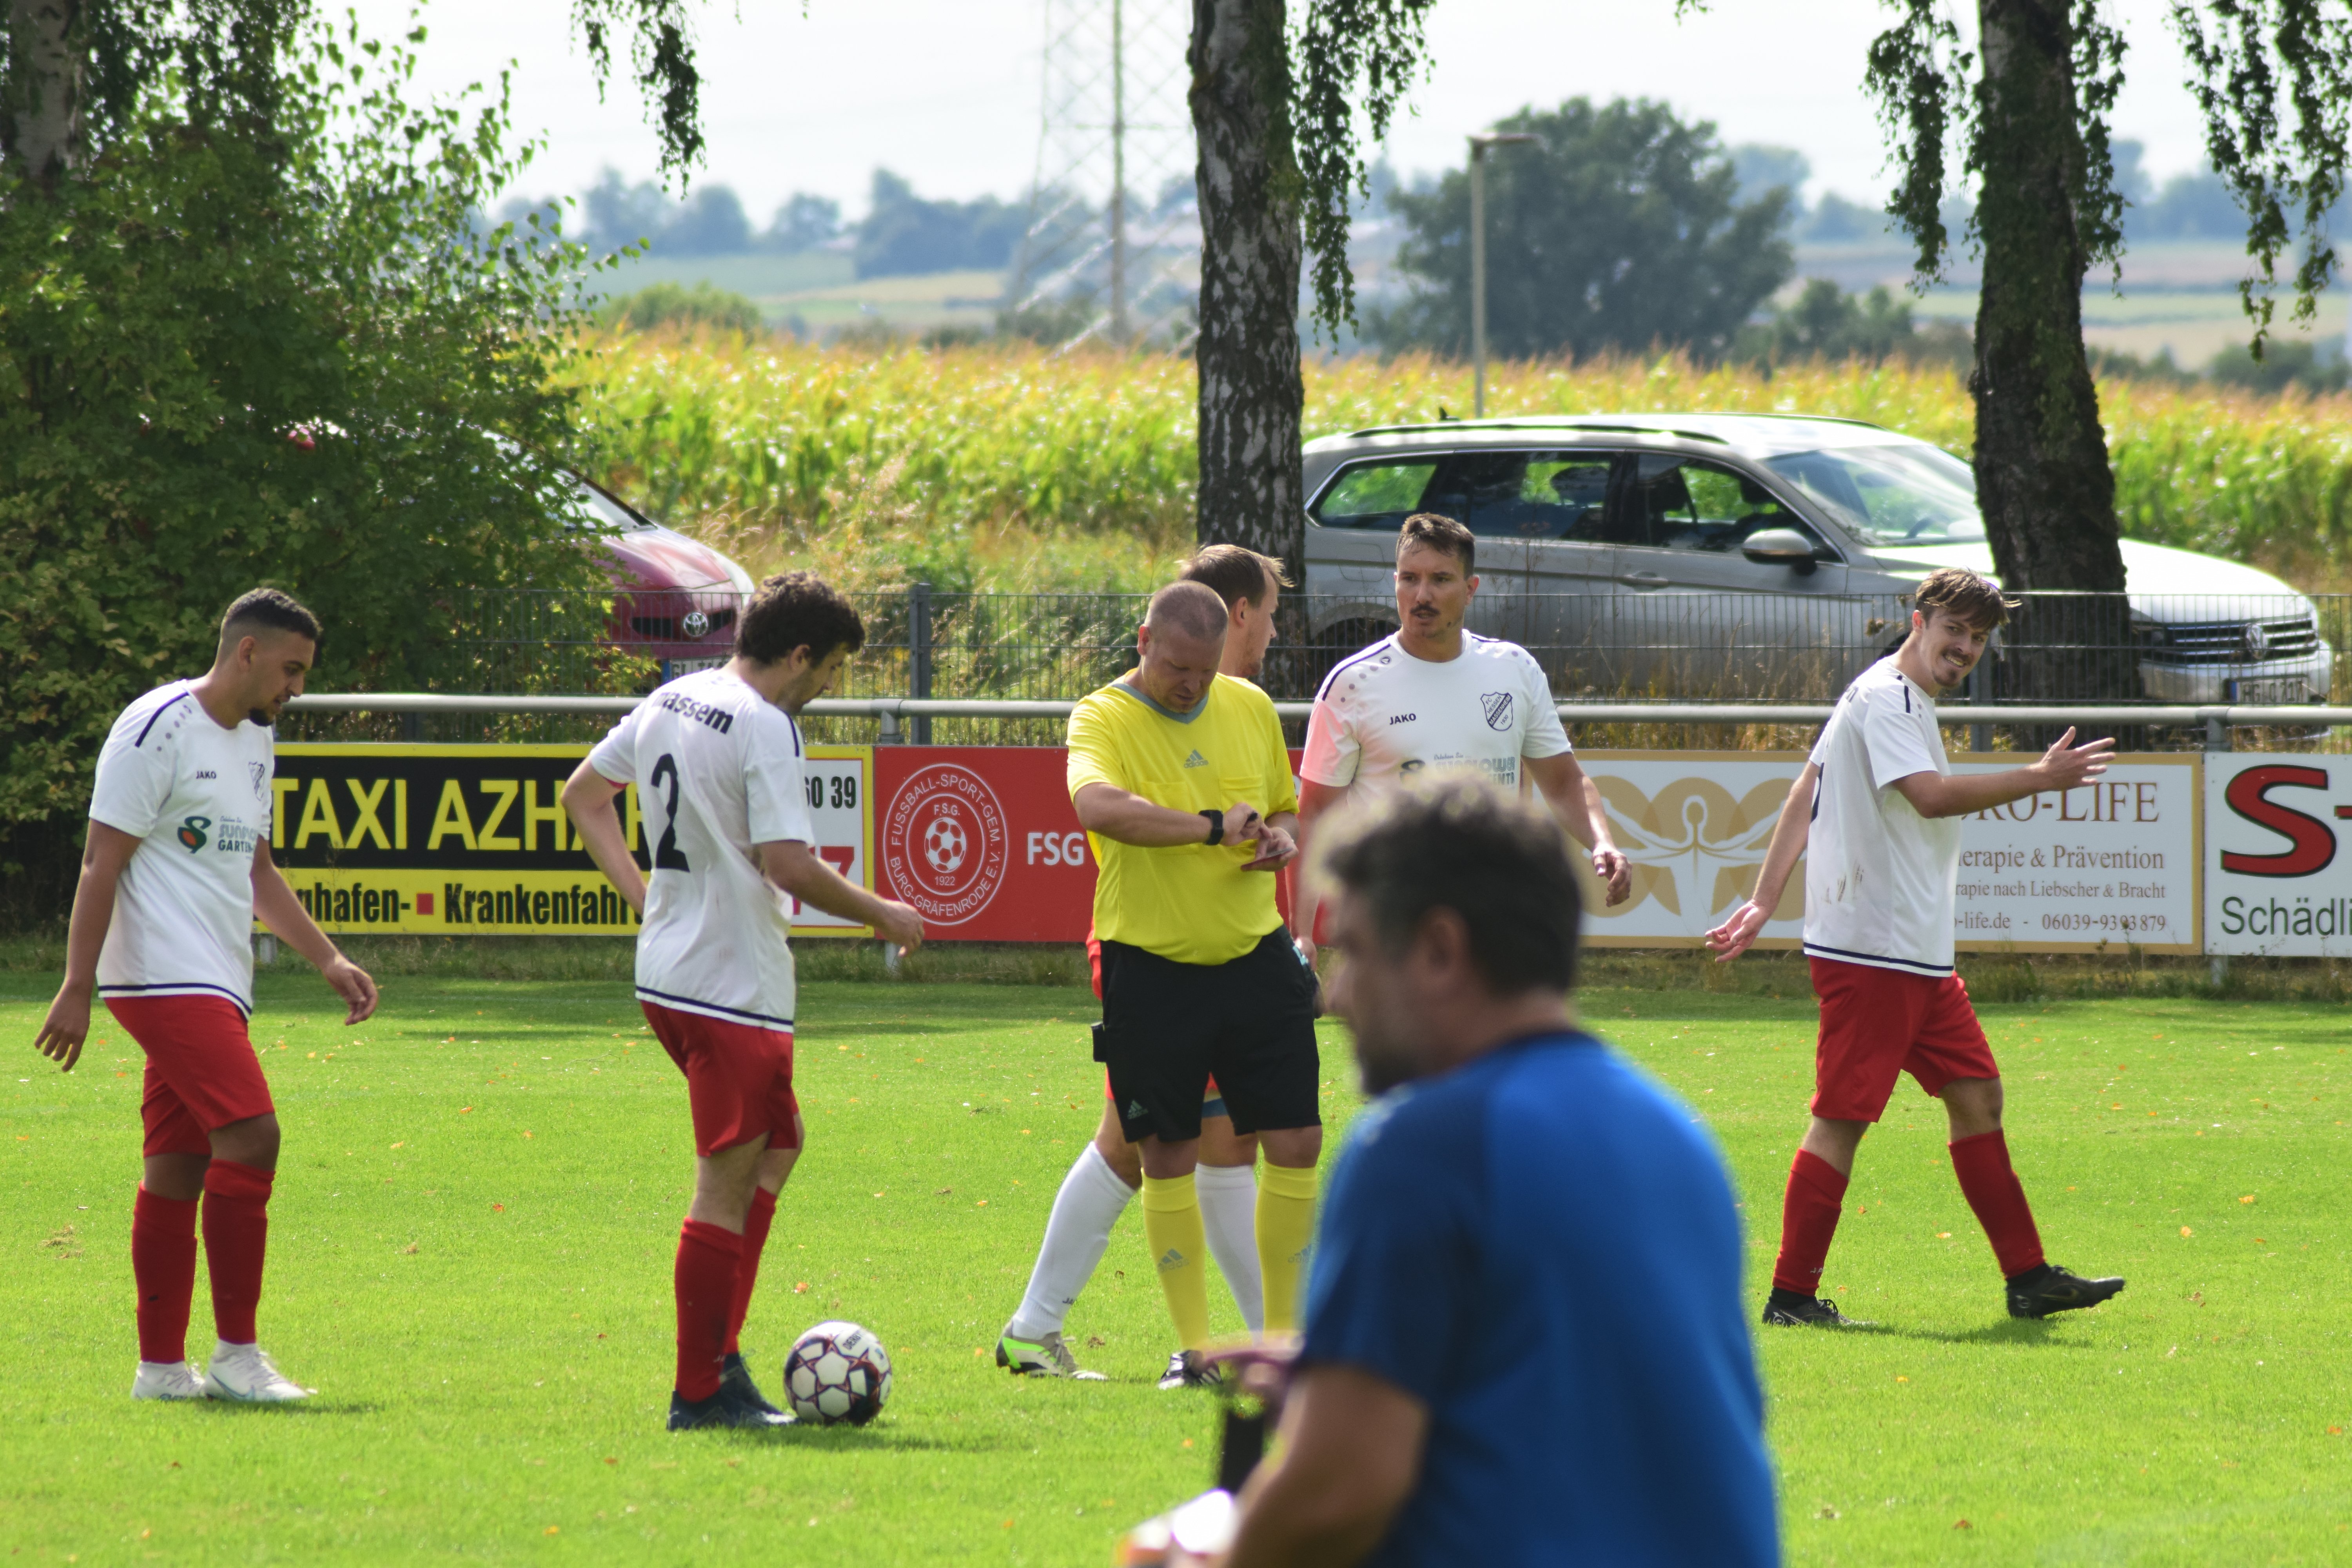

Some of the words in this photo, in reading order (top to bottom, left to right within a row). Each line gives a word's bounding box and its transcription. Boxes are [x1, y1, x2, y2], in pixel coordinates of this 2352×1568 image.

[1487, 695, 1502, 714] HESSEN
[1389, 713, 1416, 725] JAKO
[196, 771, 216, 779] JAKO
[1183, 760, 1209, 768] adidas
[830, 776, 857, 809] 39
[271, 778, 408, 850] TAXI
[651, 753, 690, 873] 2
[1027, 832, 1085, 866] FSG
[1958, 844, 2025, 874] erapie
[2030, 848, 2047, 867] &
[2052, 845, 2165, 869] Prävention
[890, 856, 991, 917] BURG-GRÄFENRODE
[935, 876, 955, 886] 1922
[1993, 880, 2026, 897] nach
[2030, 880, 2100, 898] Liebscher
[2103, 884, 2114, 898] &
[2118, 881, 2166, 898] Bracht
